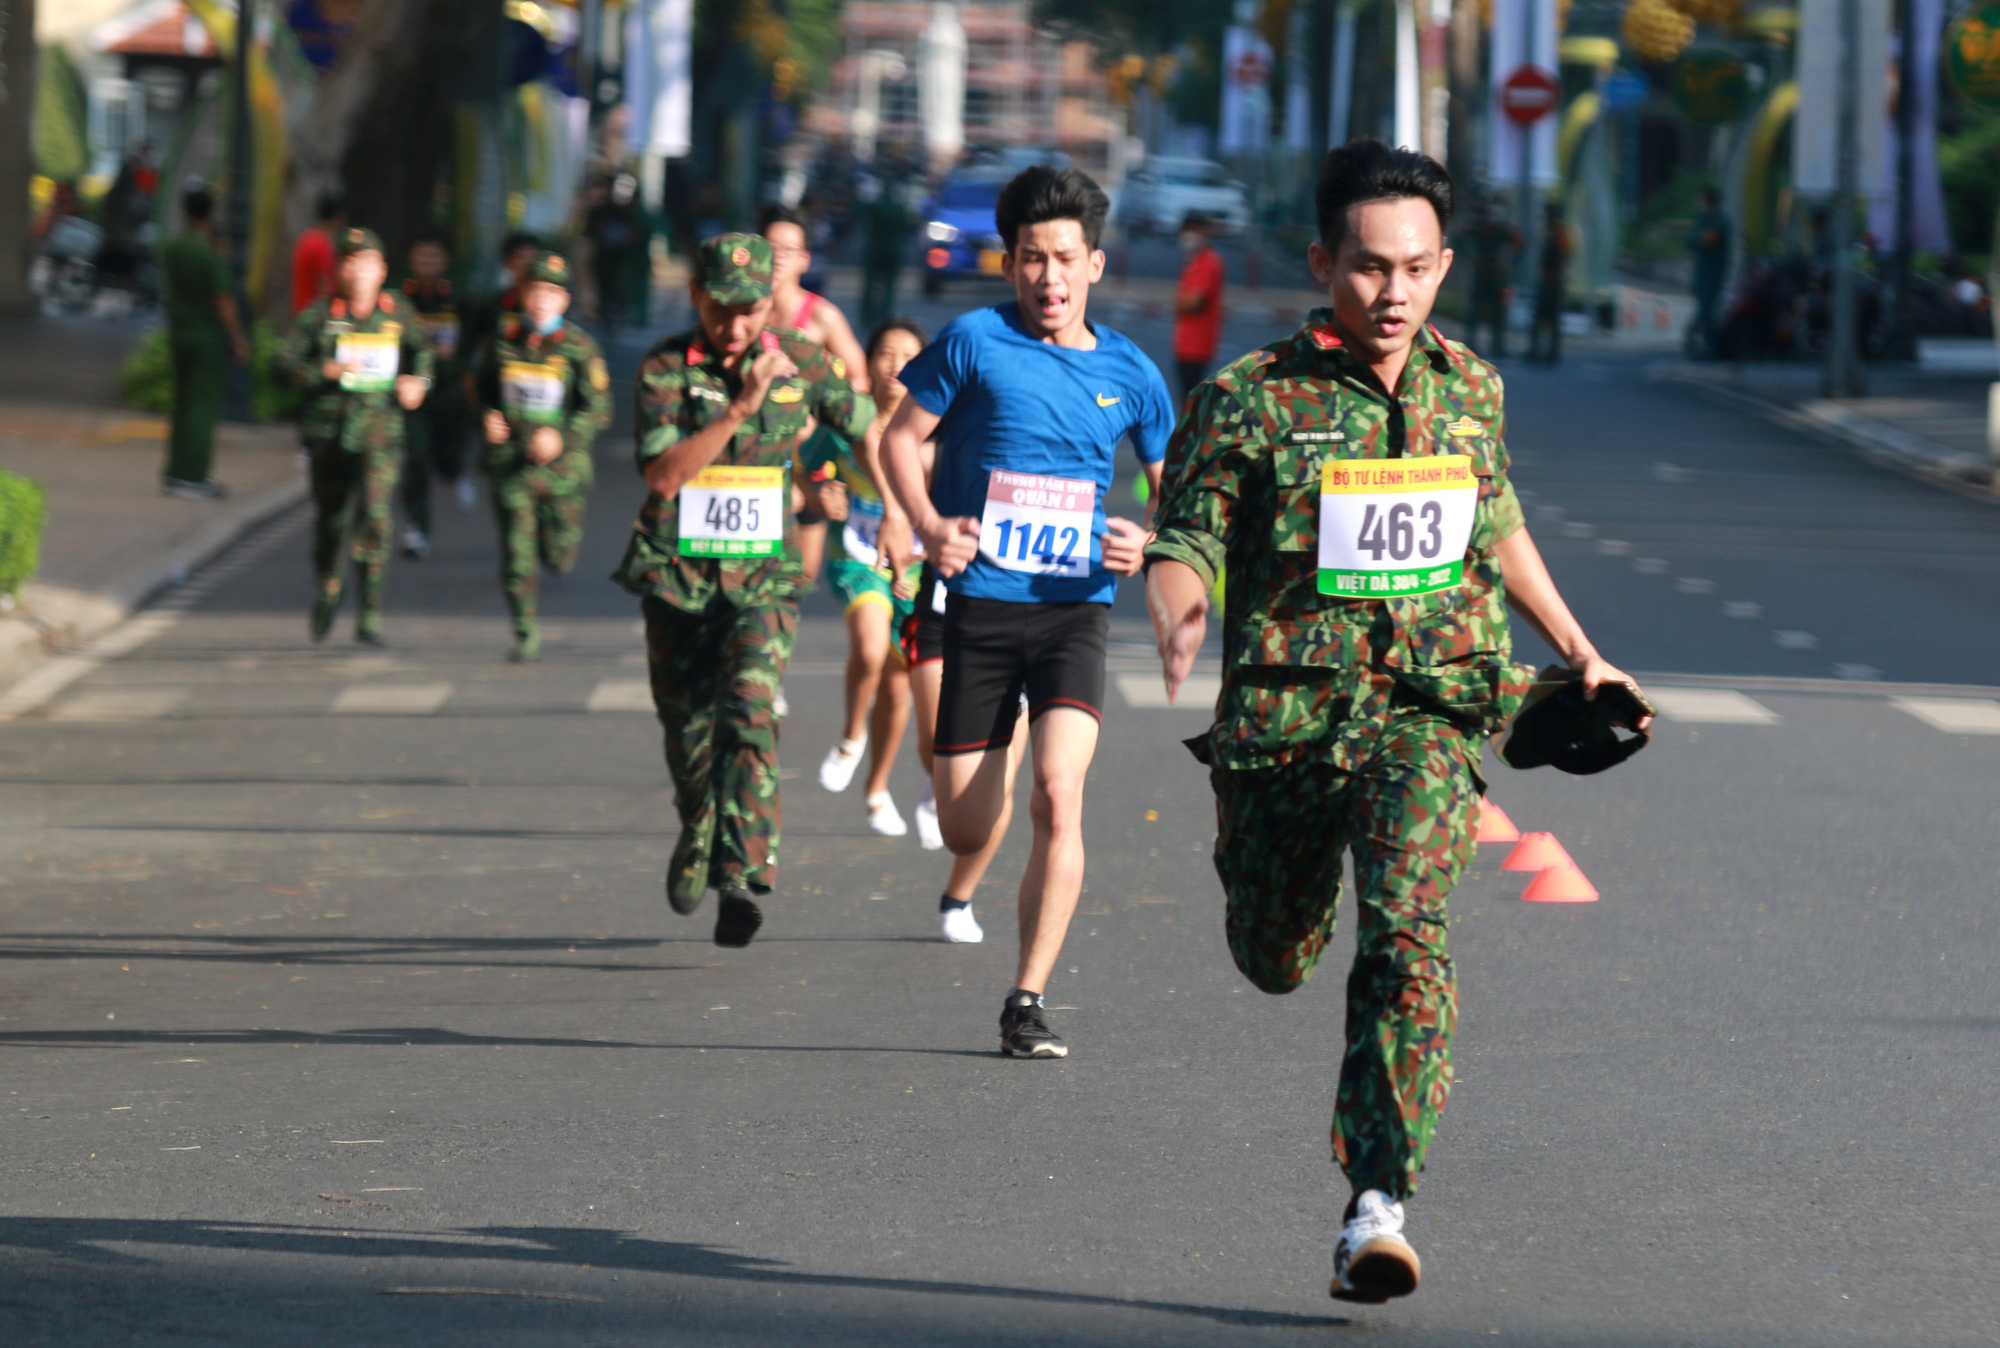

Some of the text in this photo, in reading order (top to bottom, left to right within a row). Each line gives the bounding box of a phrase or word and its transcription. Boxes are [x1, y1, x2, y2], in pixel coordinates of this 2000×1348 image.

[996, 471, 1036, 489] TRUNG
[1333, 468, 1350, 489] BỘ
[1355, 470, 1370, 485] TƯ
[1373, 468, 1404, 488] LỆNH
[1408, 466, 1442, 484] THÀNH
[706, 496, 760, 531] 485
[1065, 494, 1076, 510] 6
[1357, 500, 1442, 561] 463
[995, 519, 1079, 568] 1142
[1336, 573, 1367, 593] VIỆT
